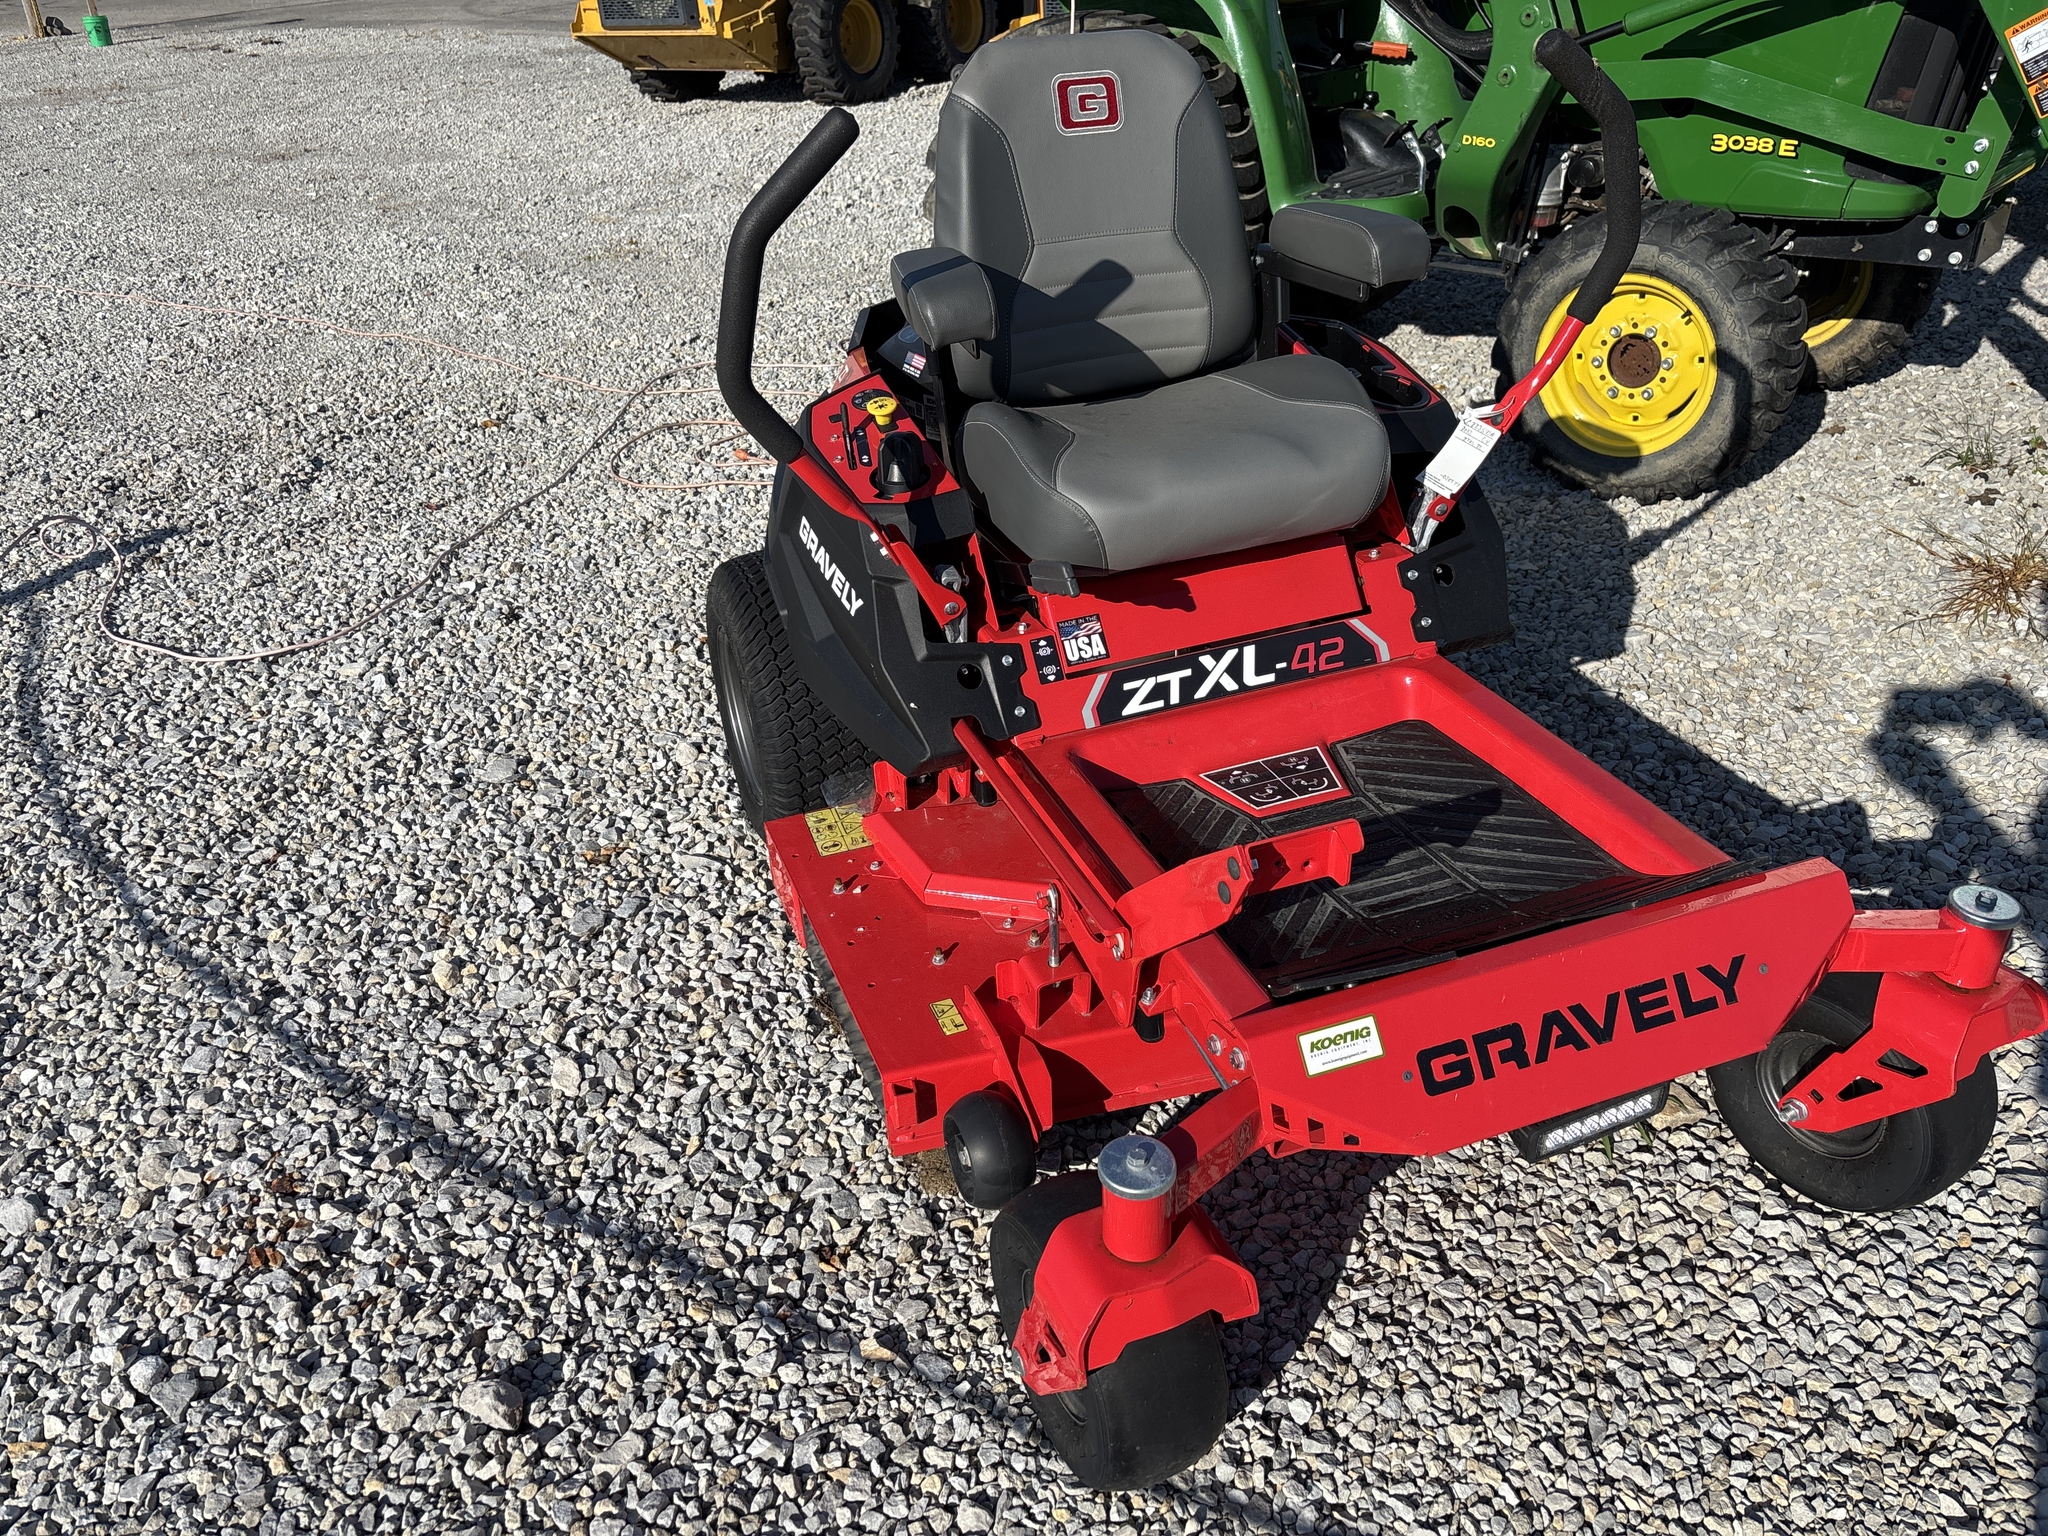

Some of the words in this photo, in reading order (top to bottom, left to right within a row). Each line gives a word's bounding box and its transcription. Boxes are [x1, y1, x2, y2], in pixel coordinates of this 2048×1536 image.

[1462, 134, 1496, 149] D160
[1710, 132, 1774, 154] 3038
[1778, 137, 1800, 158] E
[1657, 252, 1741, 339] GALAXY
[798, 515, 864, 617] GRAVELY
[1058, 620, 1077, 628] MADE
[1063, 633, 1107, 662] USA
[1416, 953, 1746, 1097] GRAVELY
